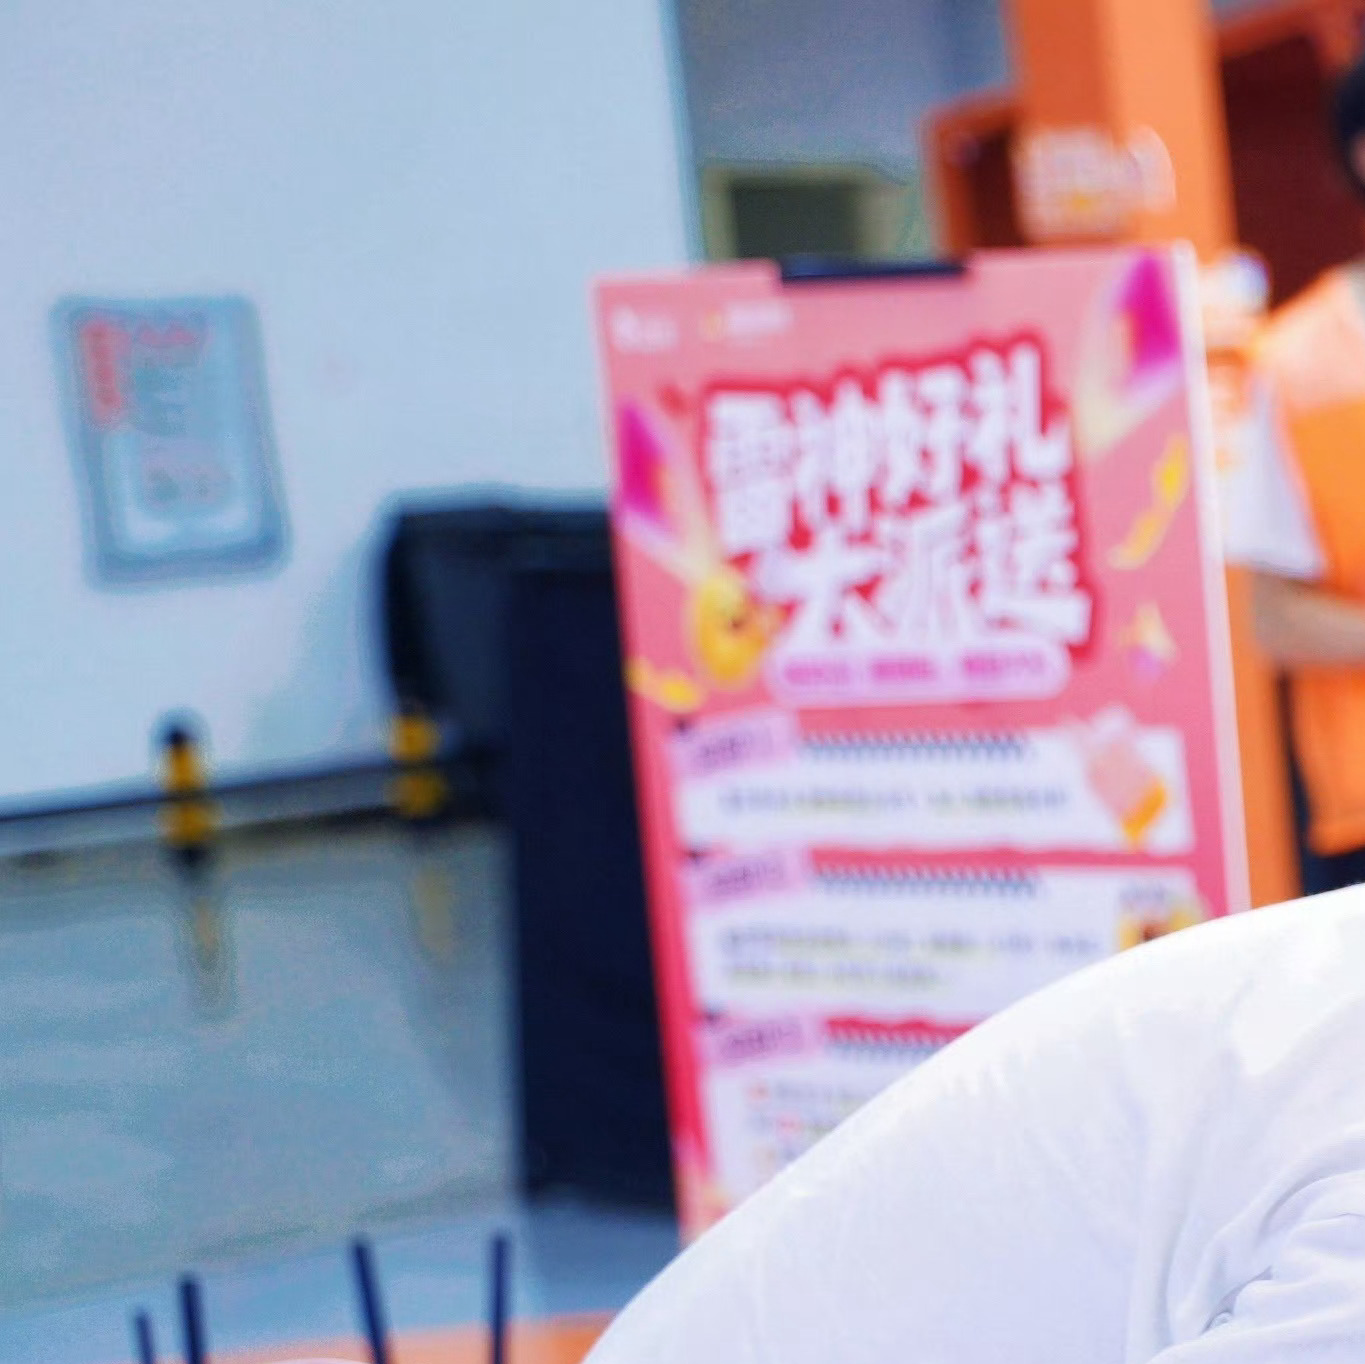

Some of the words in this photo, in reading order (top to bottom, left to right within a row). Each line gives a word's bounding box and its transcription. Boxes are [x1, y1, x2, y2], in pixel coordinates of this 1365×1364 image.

[708, 345, 1071, 555] 雷神好礼
[756, 482, 1091, 648] 大派送
